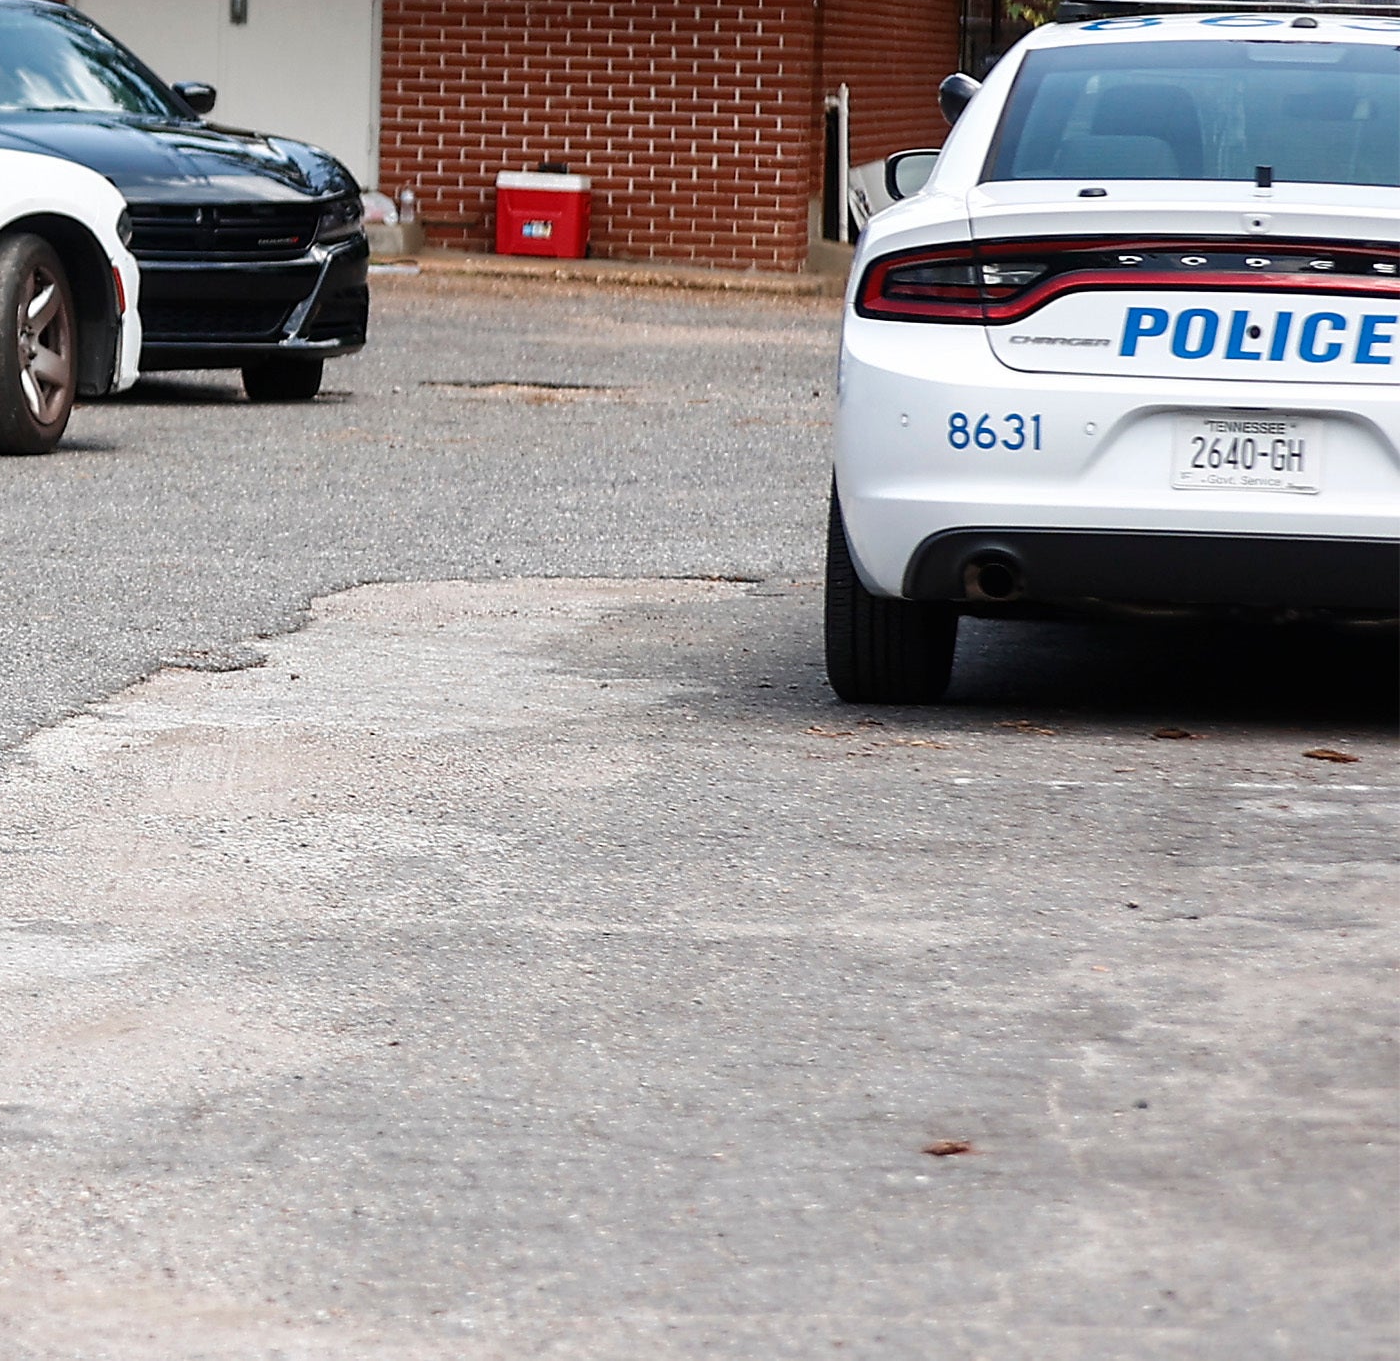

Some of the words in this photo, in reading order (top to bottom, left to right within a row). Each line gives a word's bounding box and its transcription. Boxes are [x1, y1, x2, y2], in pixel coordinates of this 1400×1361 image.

[1118, 254, 1397, 274] DODGE
[1009, 335, 1111, 348] CHARGER
[1118, 307, 1399, 365] POLICE
[948, 412, 1042, 452] 8631
[1208, 420, 1286, 434] TENNESSEE
[1191, 436, 1305, 471] 2640-GH
[1242, 476, 1282, 486] Service
